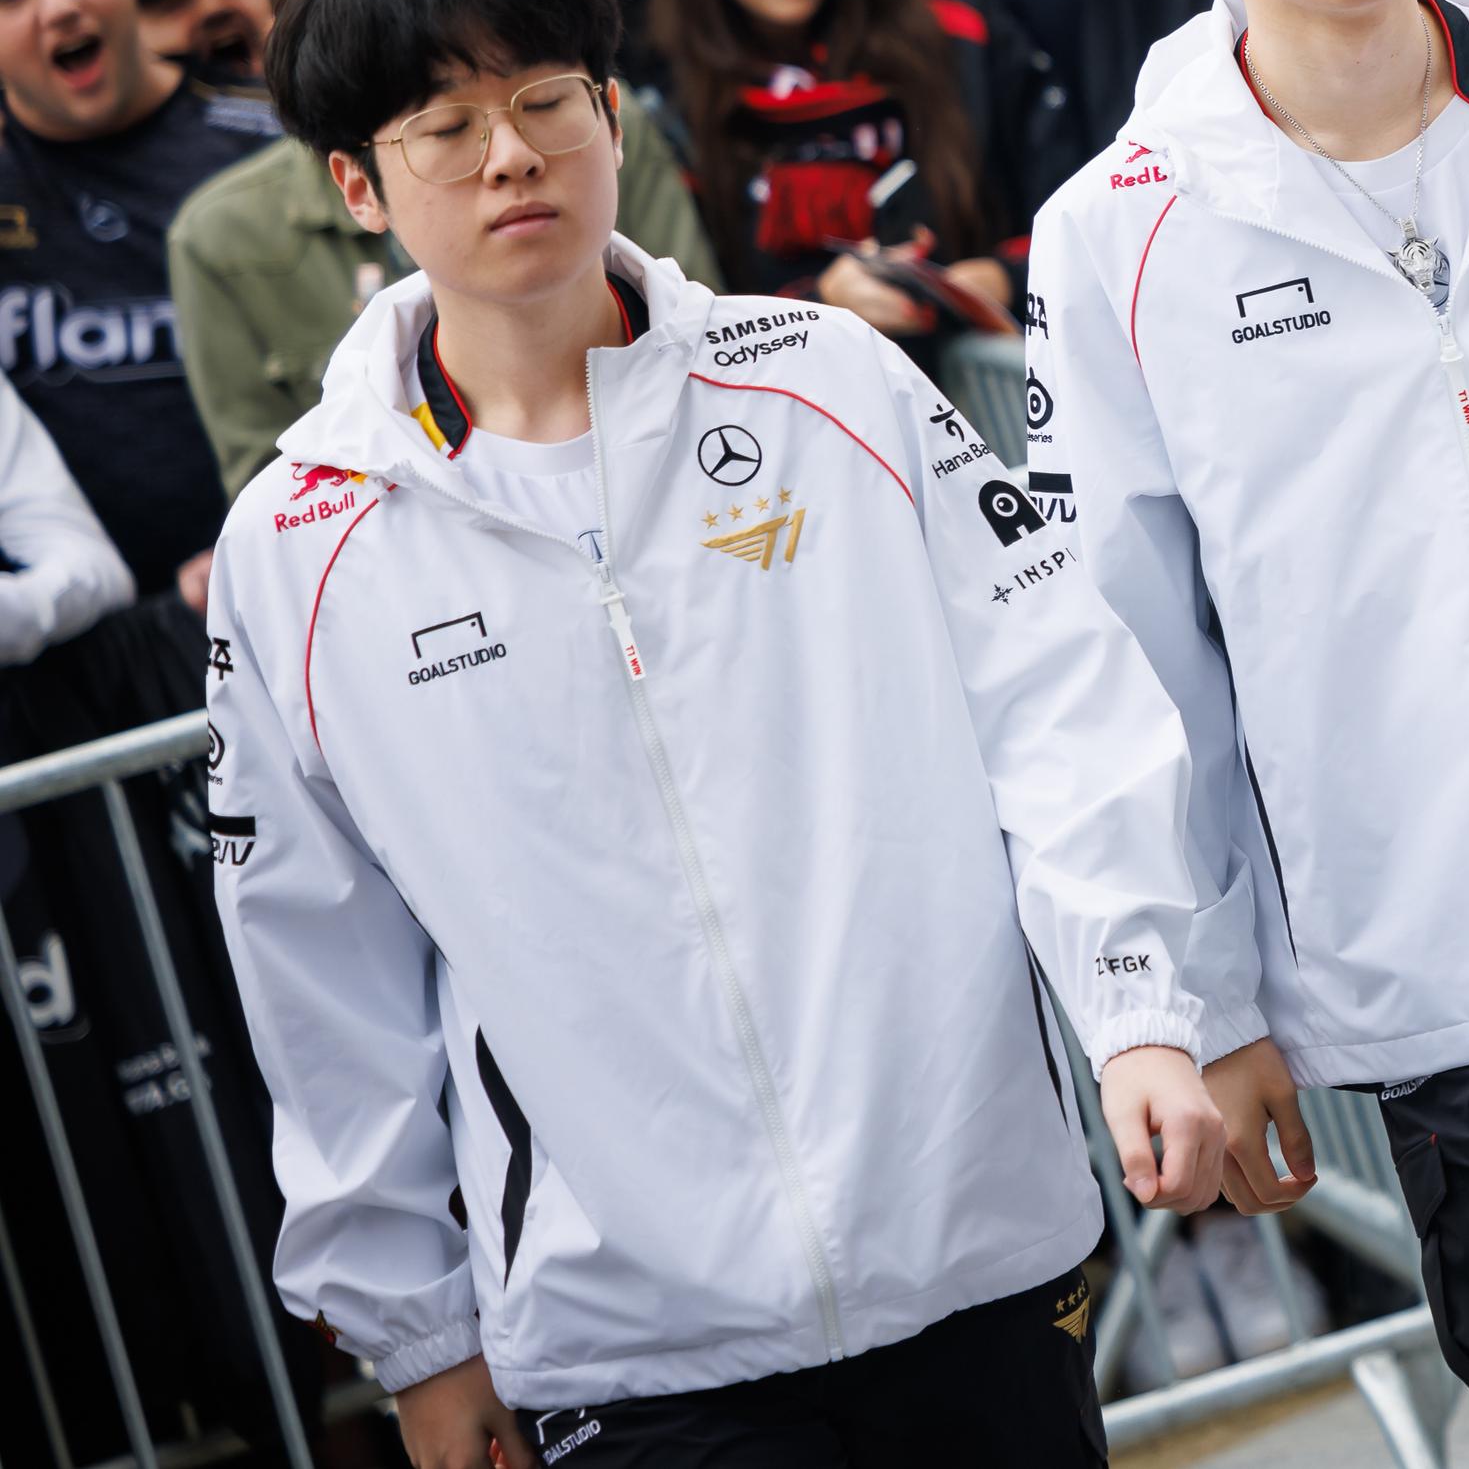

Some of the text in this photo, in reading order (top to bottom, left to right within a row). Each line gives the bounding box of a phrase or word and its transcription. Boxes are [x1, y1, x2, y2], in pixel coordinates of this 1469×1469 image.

[705, 309, 820, 345] SAMSUNG
[1231, 309, 1332, 344] GOALSTUDIO
[714, 329, 809, 367] Odyssey
[931, 448, 973, 480] Hana
[408, 642, 507, 687] GOALSTUDIO
